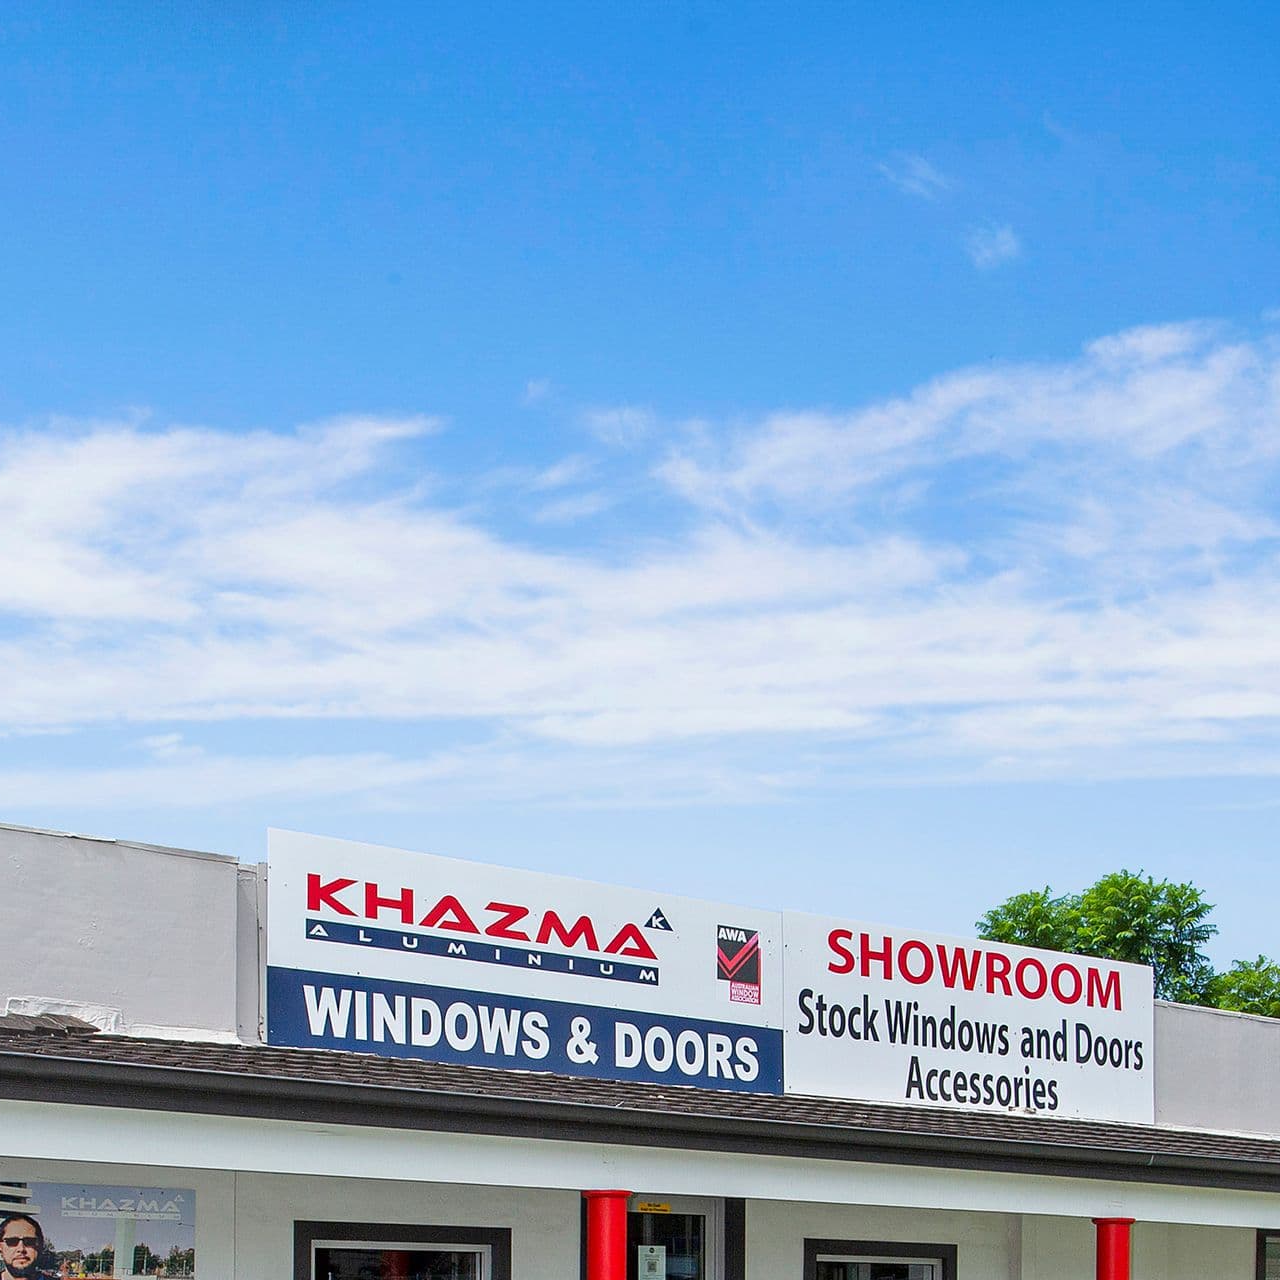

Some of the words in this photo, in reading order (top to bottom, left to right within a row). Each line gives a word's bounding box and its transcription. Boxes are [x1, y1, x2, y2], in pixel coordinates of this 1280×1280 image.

[308, 873, 658, 960] KHAZMA
[651, 915, 665, 929] K
[718, 927, 747, 943] AWA
[309, 924, 657, 982] ALUMINIUM
[827, 929, 1122, 1011] SHOWROOM
[731, 988, 759, 998] WINDOW
[303, 985, 550, 1060] WINDOWS
[566, 1016, 599, 1065] &
[615, 1022, 759, 1082] DOORS
[798, 988, 880, 1042] Stock
[884, 999, 1009, 1056] Windows
[1021, 1019, 1068, 1062] and
[1075, 1023, 1144, 1071] Doors
[905, 1056, 1059, 1110] Accessories
[61, 1196, 181, 1213] KHAZMA
